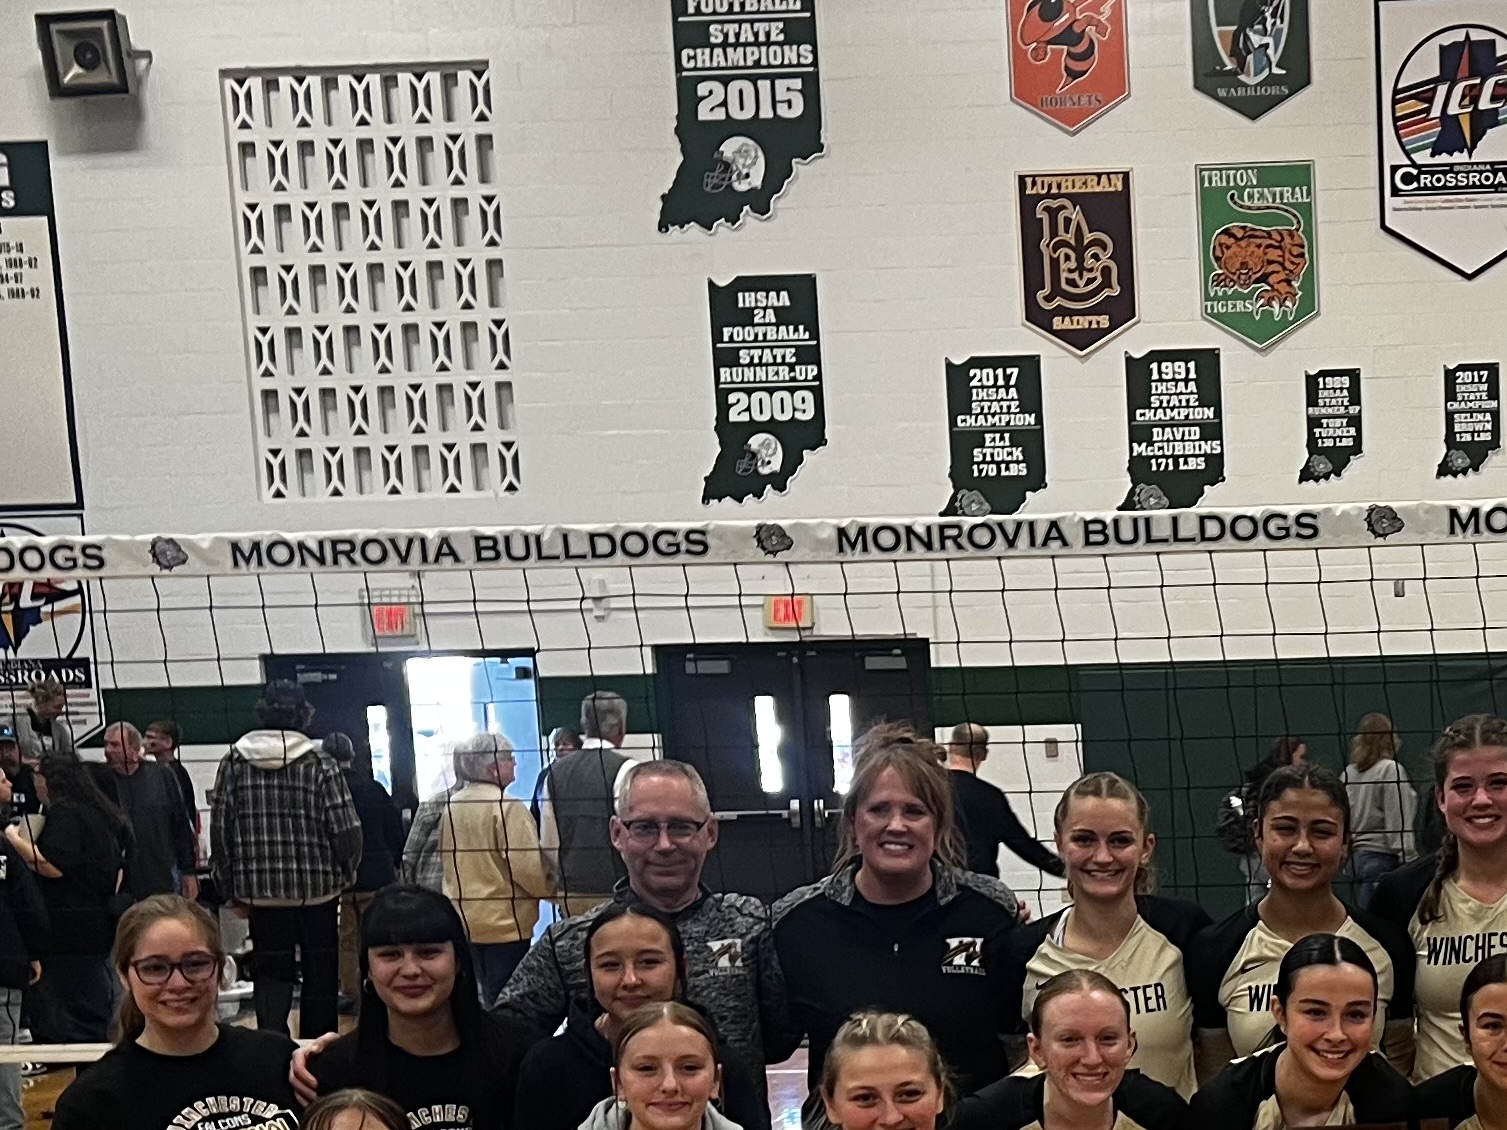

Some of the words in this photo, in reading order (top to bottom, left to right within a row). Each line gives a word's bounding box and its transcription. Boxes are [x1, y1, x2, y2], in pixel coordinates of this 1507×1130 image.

[709, 21, 784, 44] STATE
[681, 44, 814, 69] CHAMPIONS
[1216, 85, 1289, 97] WARRIORS
[697, 78, 805, 121] 2015
[1040, 95, 1102, 109] HORNETS
[1025, 173, 1124, 194] LUTHERAN
[1201, 169, 1258, 188] TRITON
[1243, 186, 1311, 204] CENTRAL
[737, 290, 791, 308] IHSAA
[1204, 300, 1253, 314] TIGERS
[753, 308, 777, 324] 2A
[1052, 315, 1110, 331] SAINTS
[722, 325, 810, 342] FOOTBALL
[739, 347, 797, 365] STATE
[719, 364, 818, 383] RUNNER-UP
[969, 367, 1019, 387] 2017
[1150, 361, 1196, 380] 1991
[1455, 371, 1488, 383] 2017
[971, 387, 1018, 400] IHSAA
[1151, 381, 1197, 394] IHSAA
[1150, 394, 1199, 408] STATE
[1318, 397, 1350, 406] STATE
[1457, 391, 1488, 400] STATE
[728, 390, 815, 423] 2009
[972, 401, 1020, 414] STATE
[1447, 400, 1498, 410] CHAMPION
[957, 413, 1036, 427] CHAMPION
[1135, 407, 1214, 421] CHAMPION
[984, 432, 1010, 447] ELI
[1152, 427, 1200, 441] DAVID
[973, 447, 1023, 462] STOCK
[1132, 440, 1221, 456] McCUBBINS
[972, 464, 997, 477] 170
[1000, 463, 1027, 476] LBS
[1150, 458, 1174, 471] 171
[1179, 457, 1206, 470] LBS
[837, 519, 1069, 555] MONROVIA
[1082, 512, 1320, 549] BULLDOGS
[230, 535, 462, 569] MONROVIA
[474, 529, 710, 562] BULLDOGS
